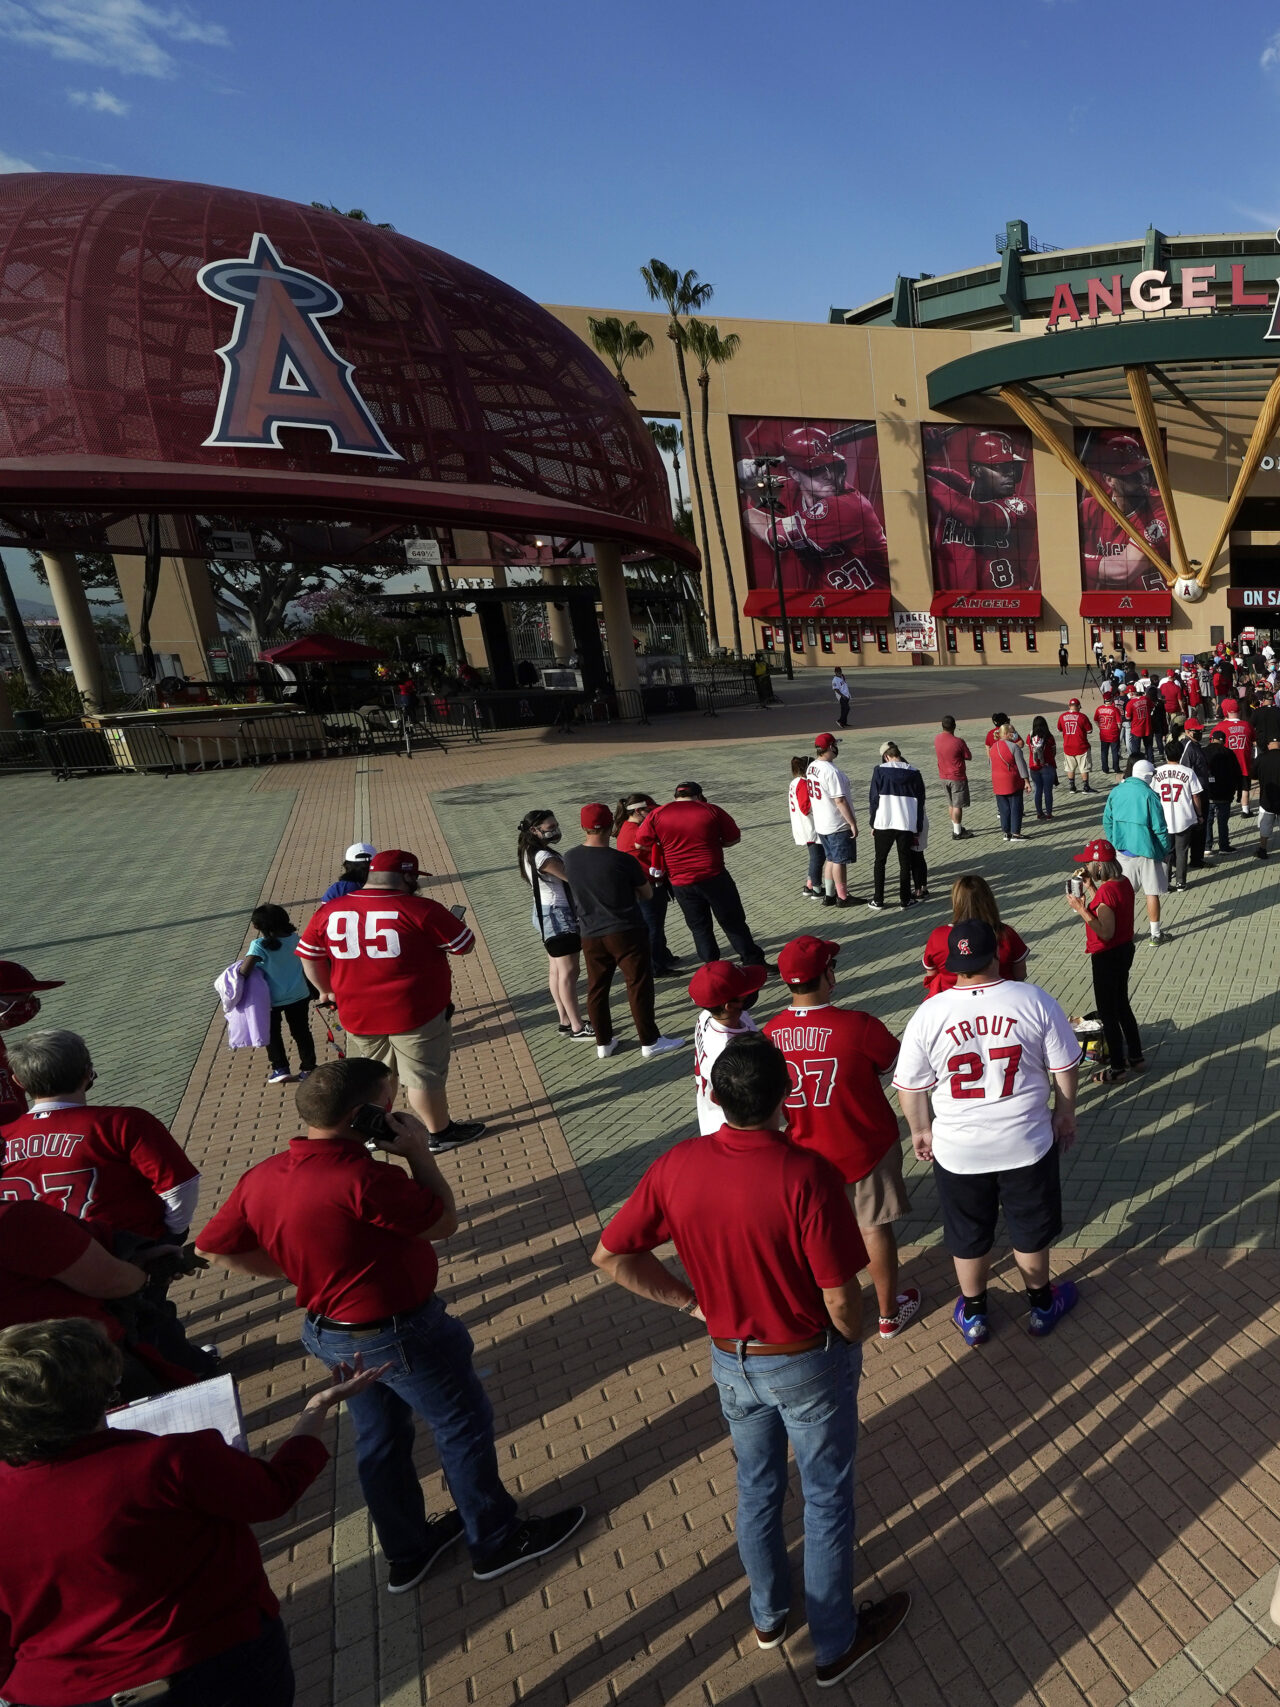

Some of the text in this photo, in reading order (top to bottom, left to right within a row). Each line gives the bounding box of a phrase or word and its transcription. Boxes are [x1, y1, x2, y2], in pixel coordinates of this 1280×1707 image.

[1047, 264, 1269, 327] ANGEL
[196, 232, 405, 461] A
[990, 558, 1014, 588] 8
[953, 596, 1020, 608] ANGELS
[1243, 591, 1263, 605] ON
[899, 613, 933, 624] ANGELS
[1065, 722, 1078, 734] 17
[1228, 735, 1247, 749] 27
[1161, 784, 1183, 802] 27
[326, 911, 401, 959] 95
[772, 1027, 833, 1052] TROUT
[945, 1015, 1018, 1047] TROUT
[785, 1058, 838, 1107] 27
[947, 1045, 1022, 1099] 27
